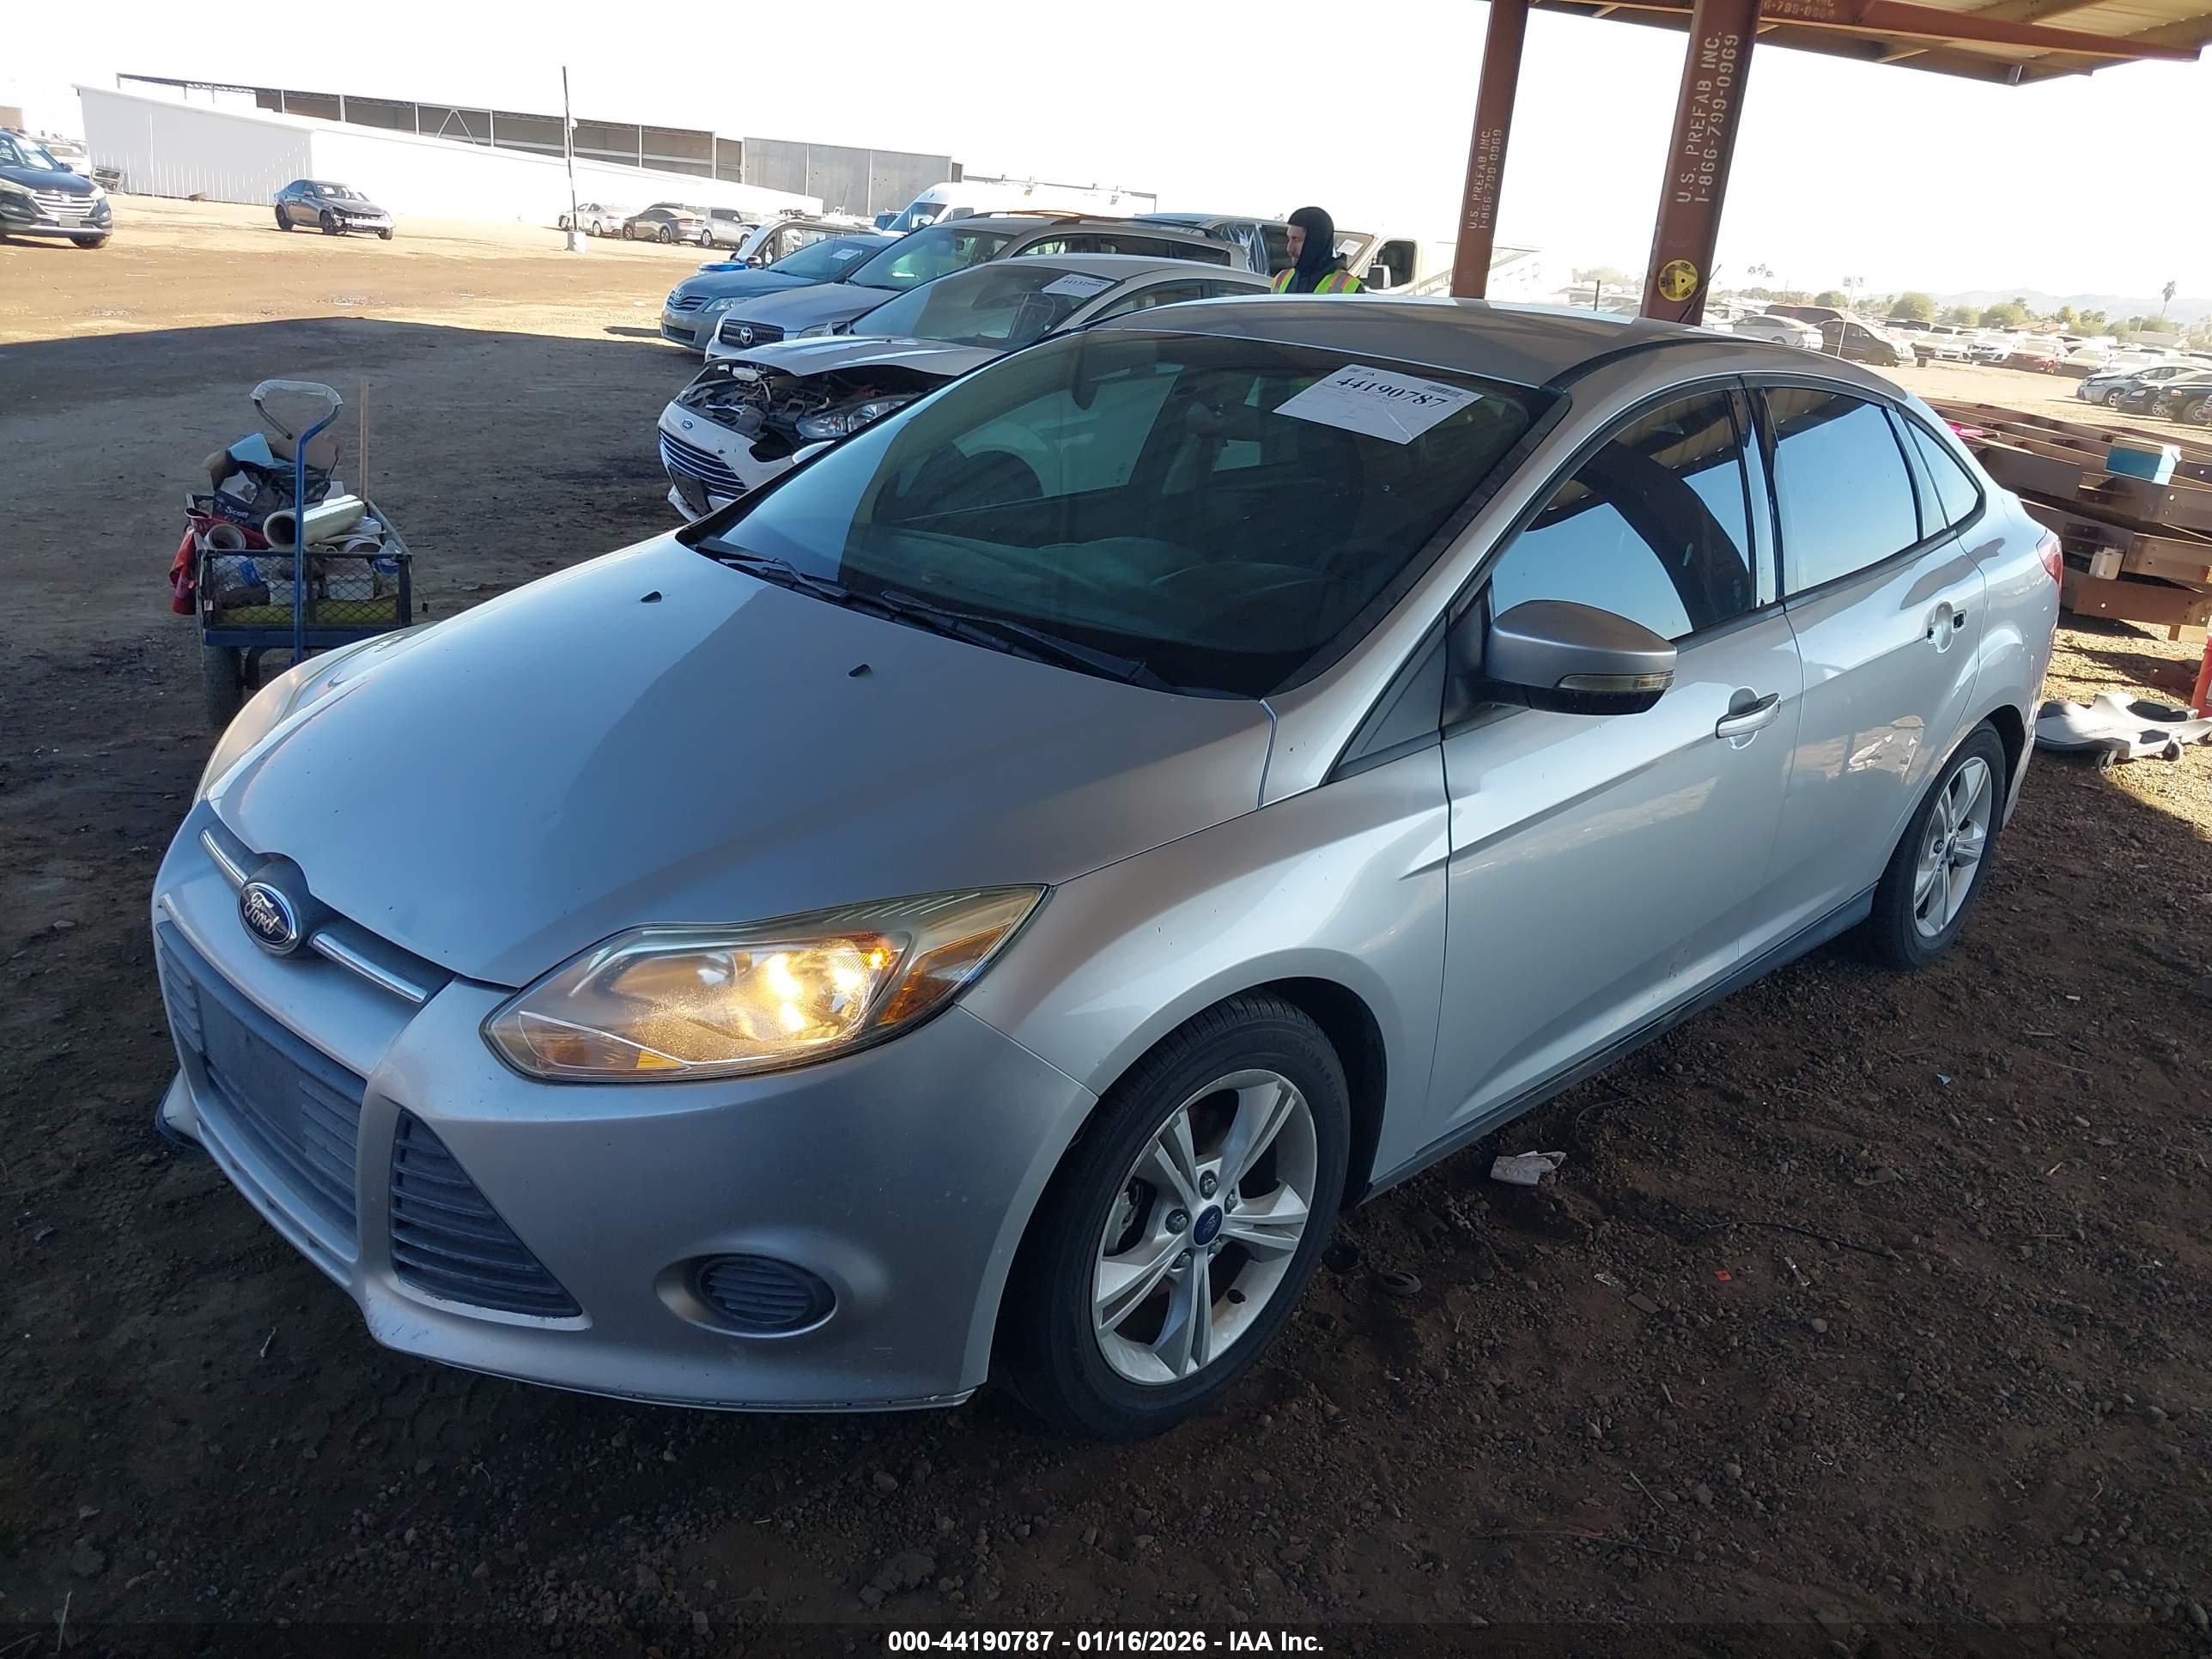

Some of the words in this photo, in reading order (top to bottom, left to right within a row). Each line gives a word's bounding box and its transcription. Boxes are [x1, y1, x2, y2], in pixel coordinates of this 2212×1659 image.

[1700, 31, 1723, 69] INC.
[1685, 79, 1712, 155] PREFAB
[1694, 33, 1739, 203] 1-866-799-0969
[1472, 156, 1487, 201] PREFAB
[1675, 167, 1697, 203] U.S.
[1468, 207, 1480, 229] U.S.
[1336, 377, 1449, 409] 44190787
[244, 891, 280, 935] Ford
